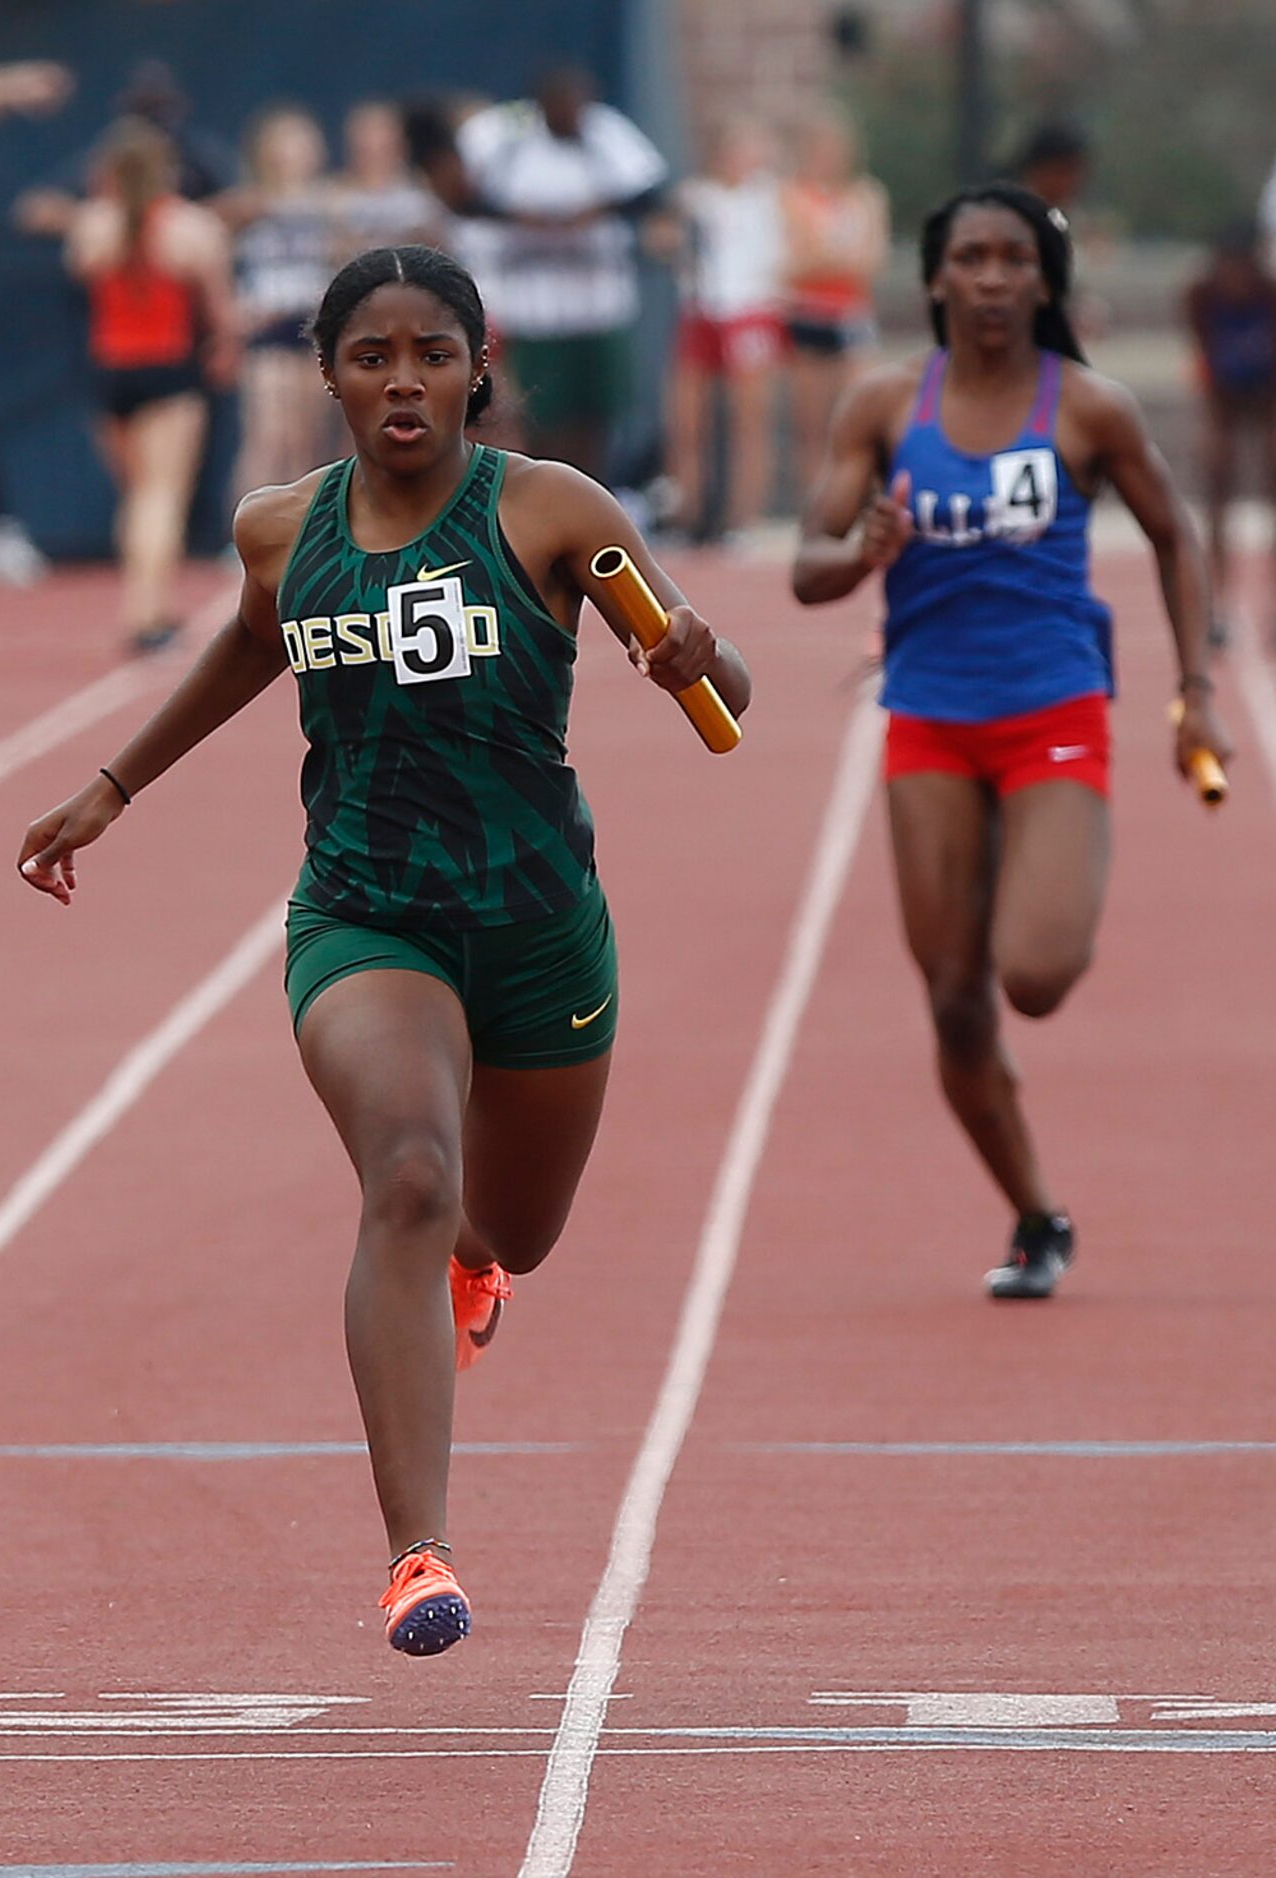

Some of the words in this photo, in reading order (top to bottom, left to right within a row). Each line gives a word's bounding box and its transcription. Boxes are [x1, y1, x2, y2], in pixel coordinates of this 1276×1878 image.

[1009, 463, 1044, 518] 4
[281, 605, 502, 674] DESO
[400, 587, 454, 675] 5
